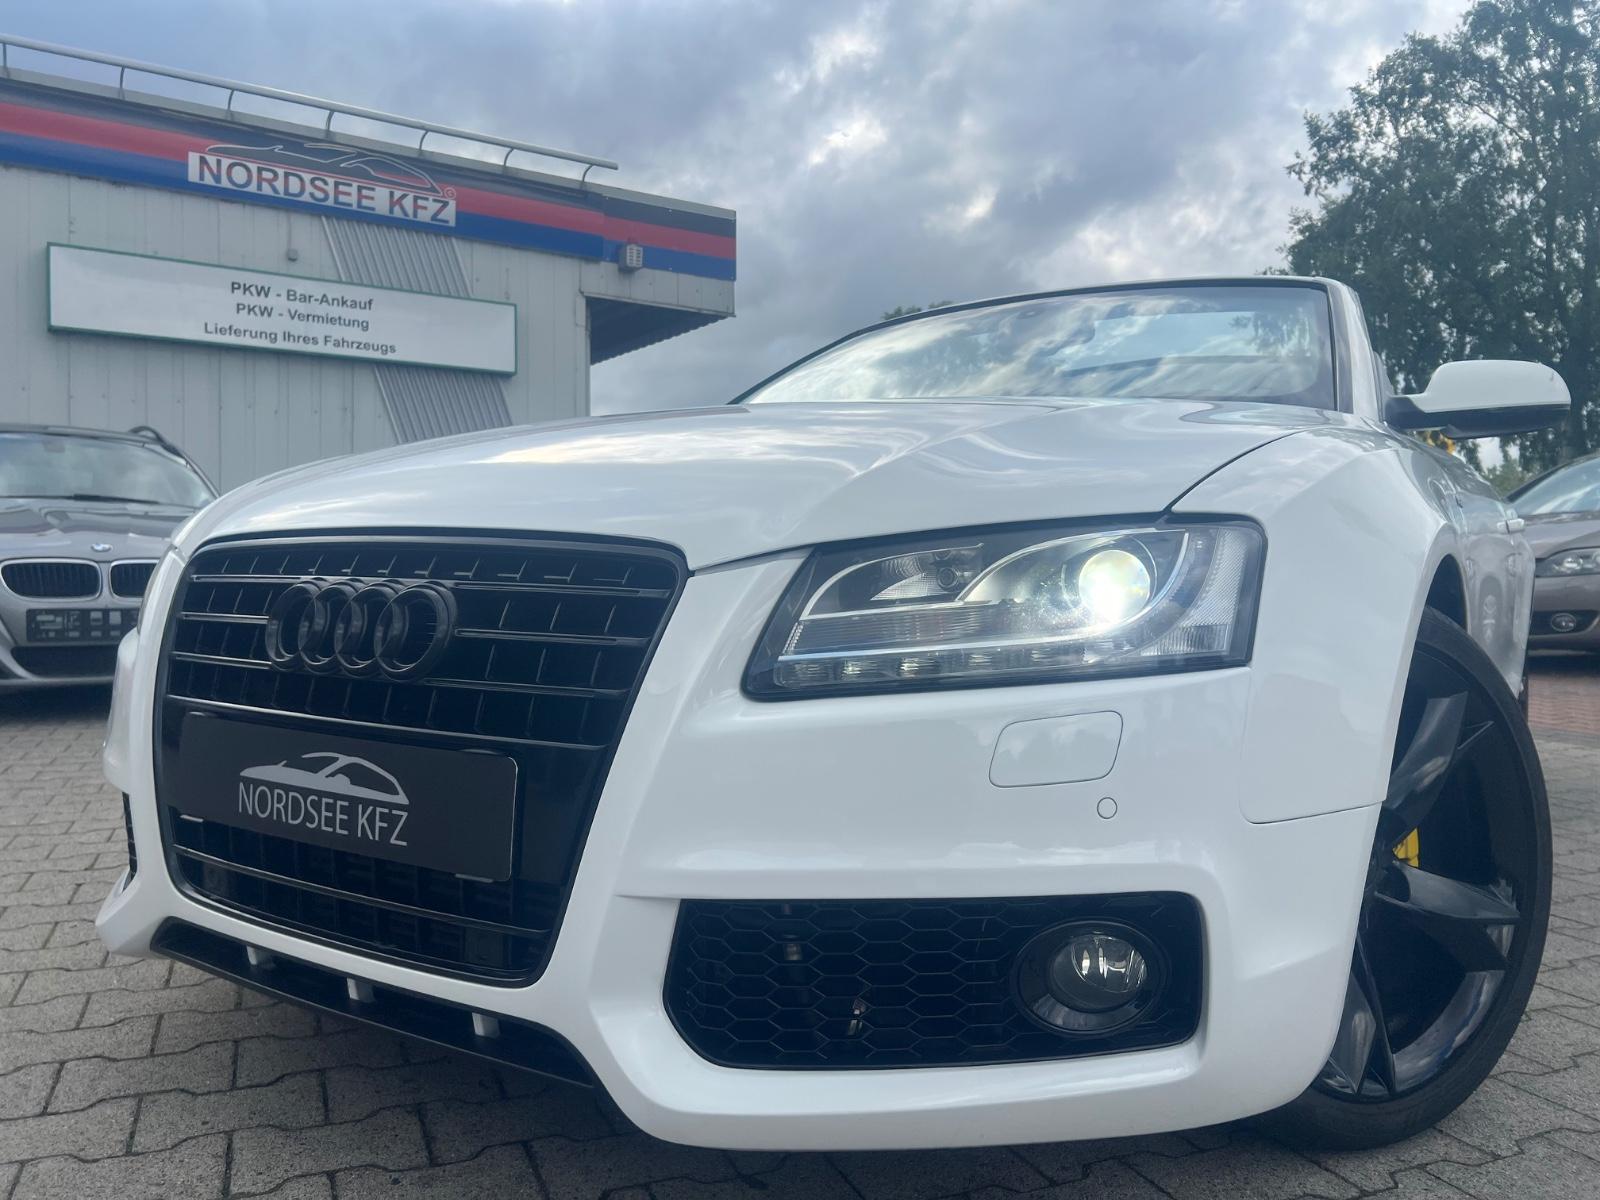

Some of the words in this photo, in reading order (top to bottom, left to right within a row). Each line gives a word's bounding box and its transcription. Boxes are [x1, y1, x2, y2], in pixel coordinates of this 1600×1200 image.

[198, 155, 376, 212] NORDSEE
[388, 190, 450, 224] KFZ
[231, 281, 271, 299] PKW
[286, 289, 373, 311] Bar-Ankauf
[236, 303, 273, 318] PKW
[288, 308, 370, 332] Vermietung
[204, 322, 278, 344] Lieferung
[283, 331, 319, 346] Ihres
[324, 335, 397, 355] Fahrzeugs
[238, 782, 350, 835] NORDSEE
[357, 804, 408, 846] KFZ
